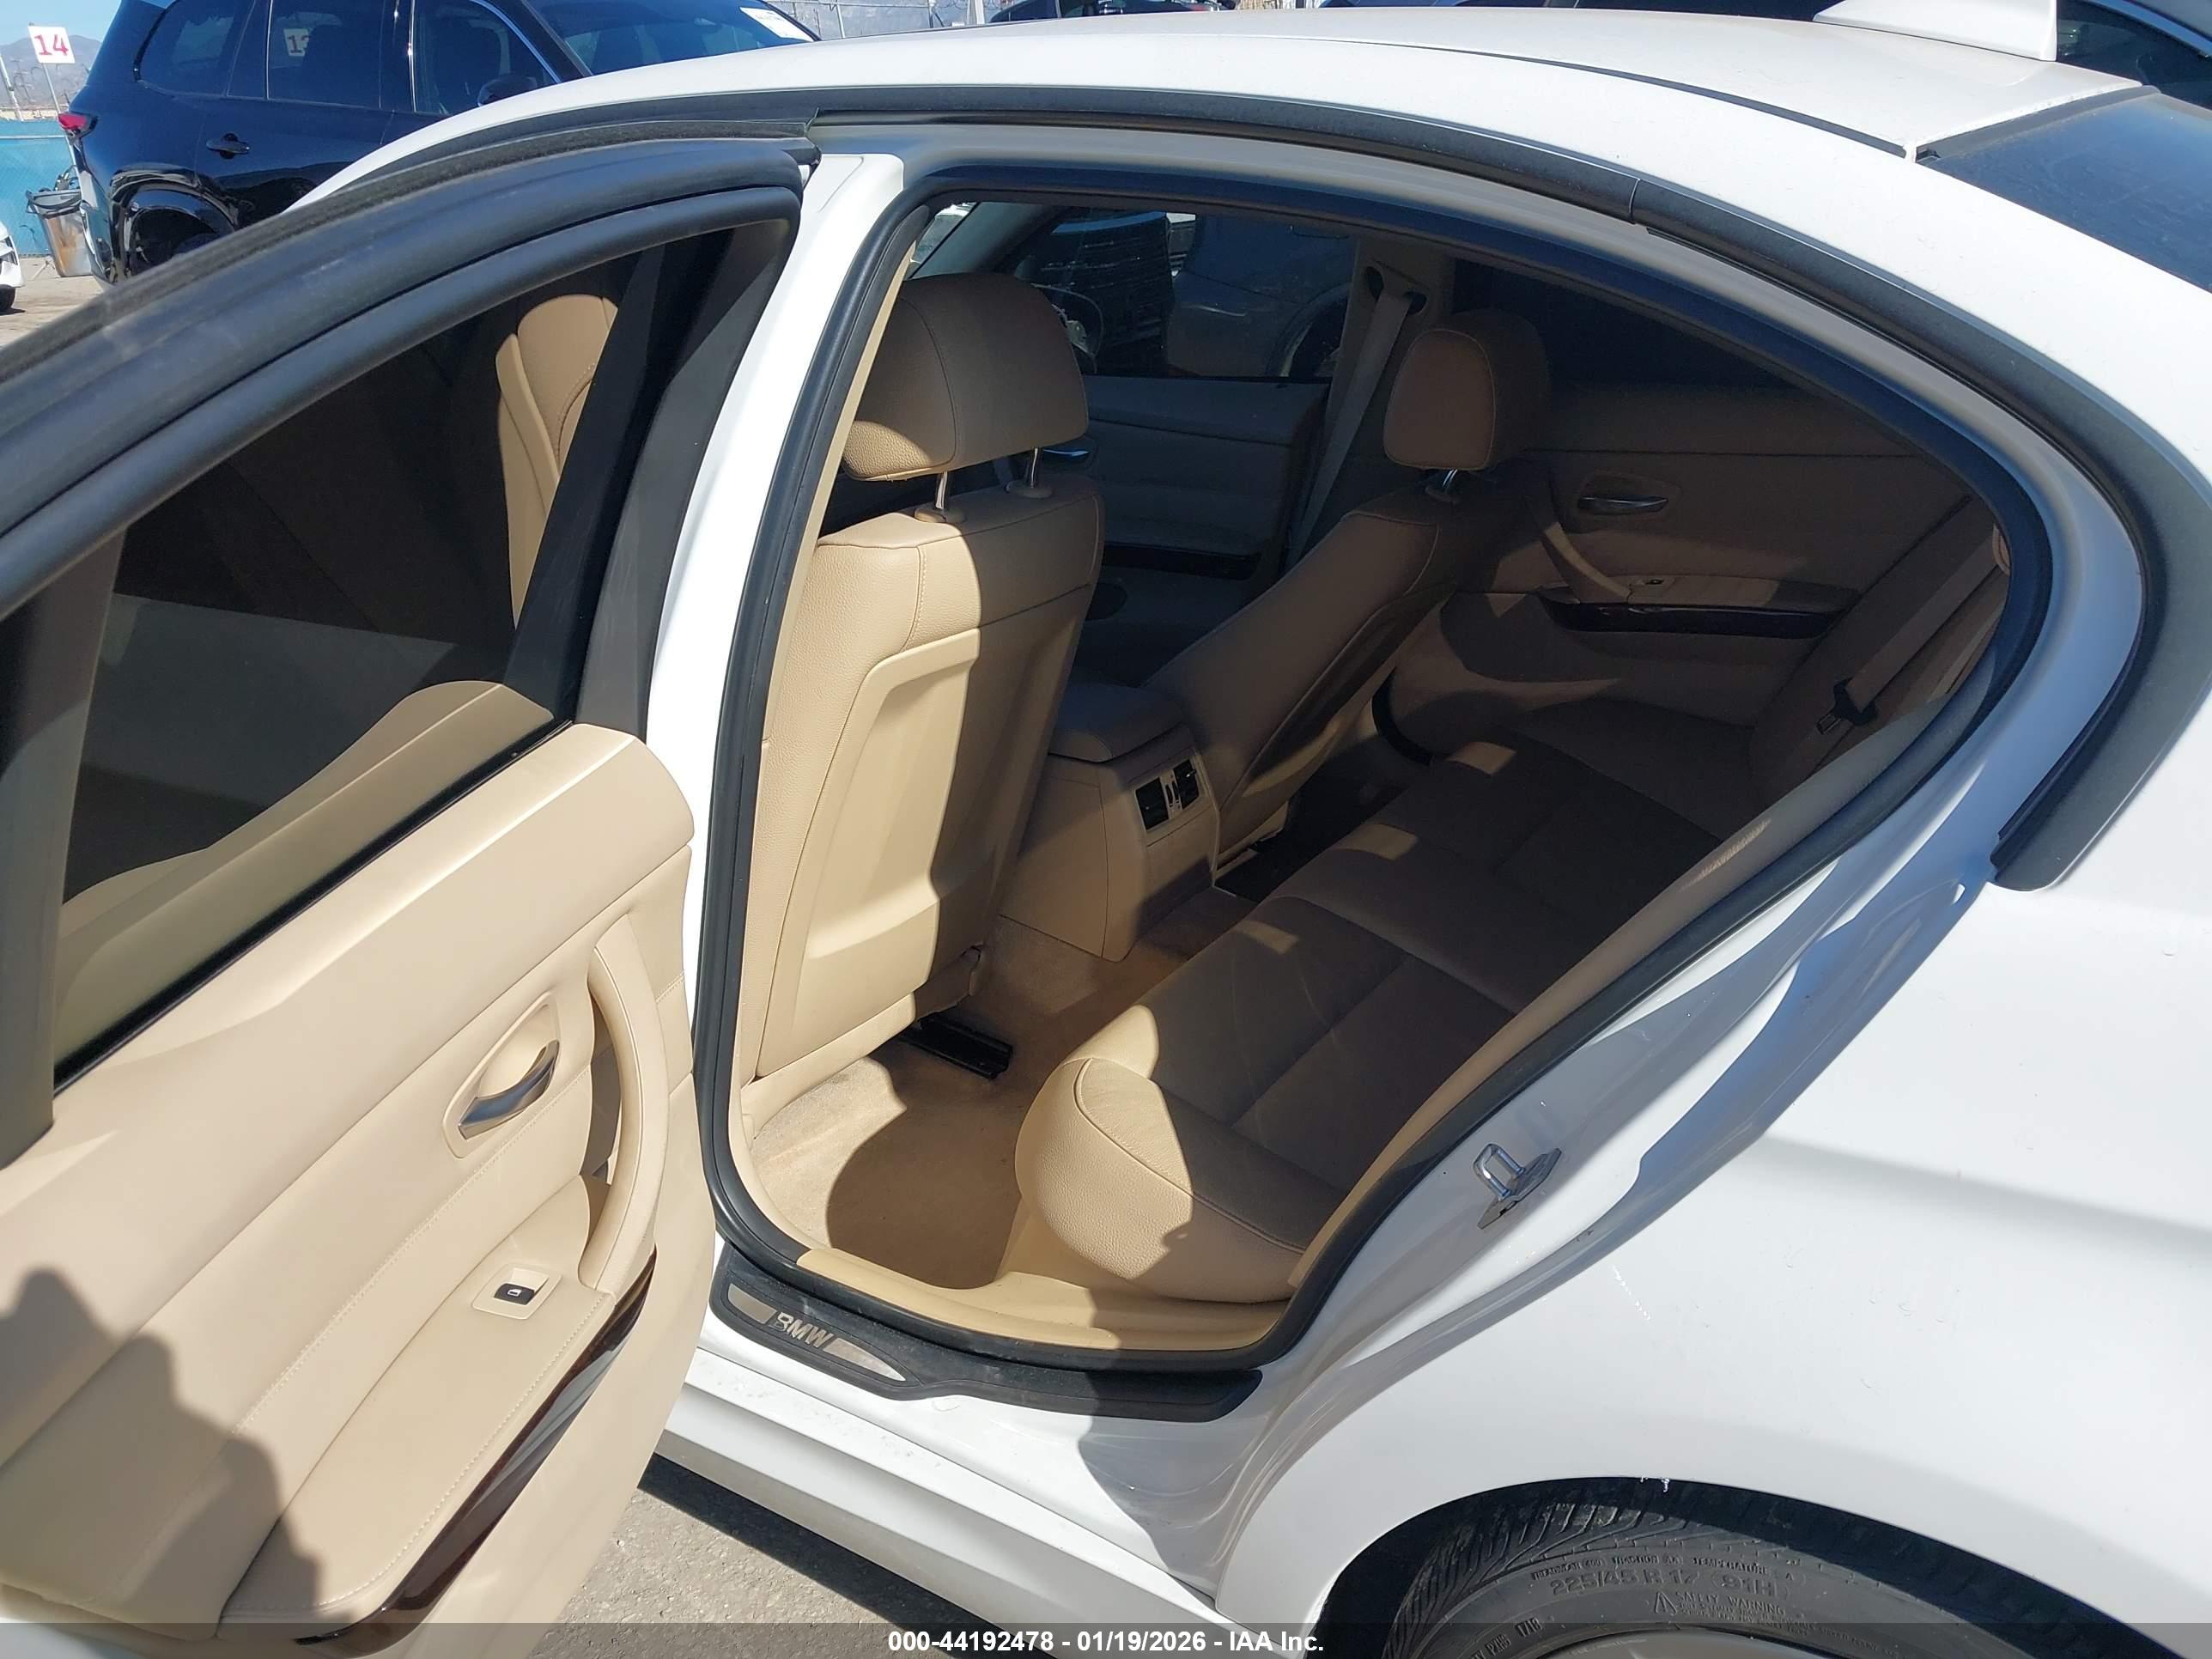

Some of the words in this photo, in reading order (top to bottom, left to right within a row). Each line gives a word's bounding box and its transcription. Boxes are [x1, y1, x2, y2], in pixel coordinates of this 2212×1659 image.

[34, 34, 69, 56] 14
[769, 1311, 835, 1348] BMW
[1550, 1570, 1639, 1595] 225/45
[1728, 1595, 1786, 1616] WARNING
